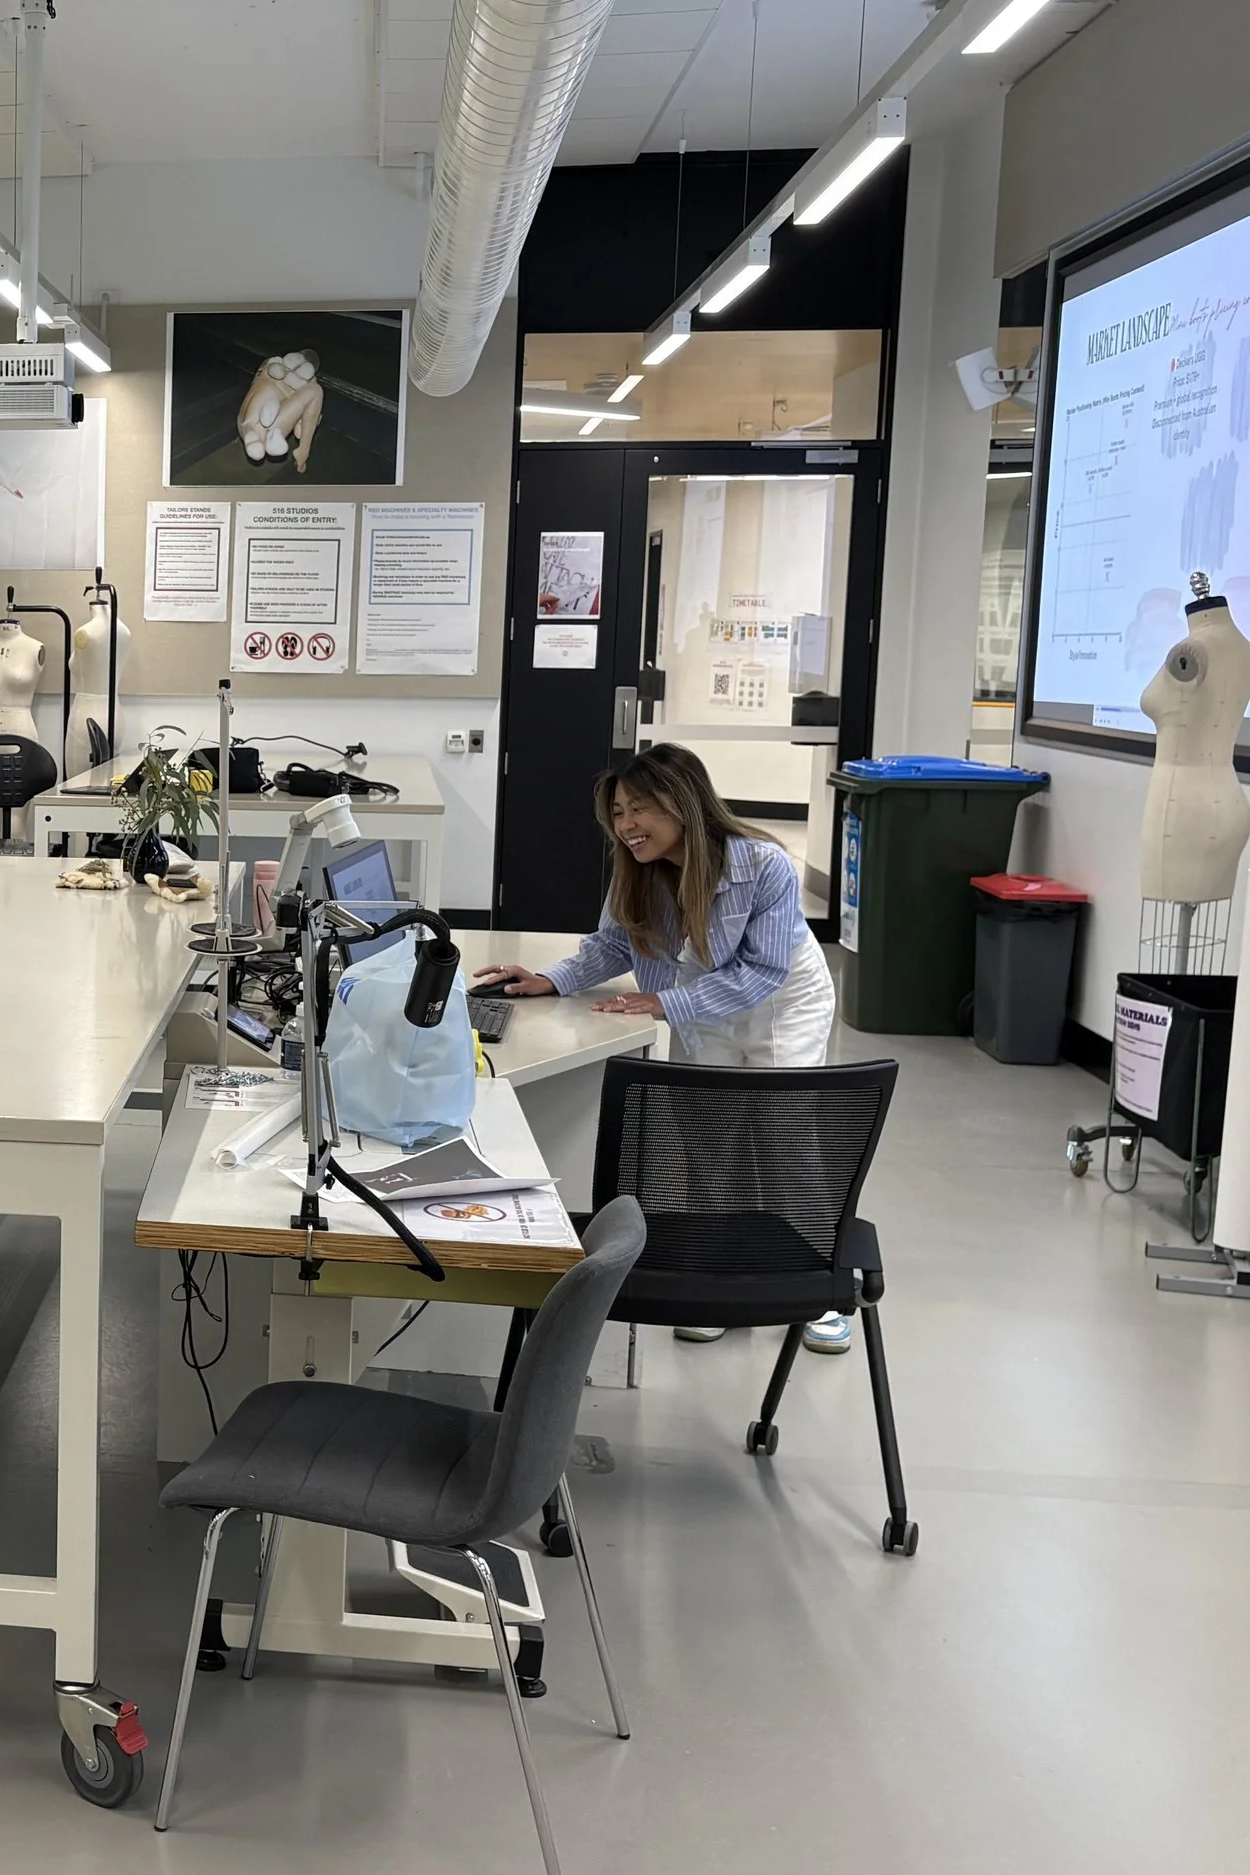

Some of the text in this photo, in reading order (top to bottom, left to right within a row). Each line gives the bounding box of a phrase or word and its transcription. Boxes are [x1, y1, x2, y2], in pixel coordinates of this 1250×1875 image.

[1086, 302, 1171, 366] MARKET LANDSCAPE
[732, 599, 766, 607] TIMETABLE
[1120, 1007, 1168, 1027] MATERIALS
